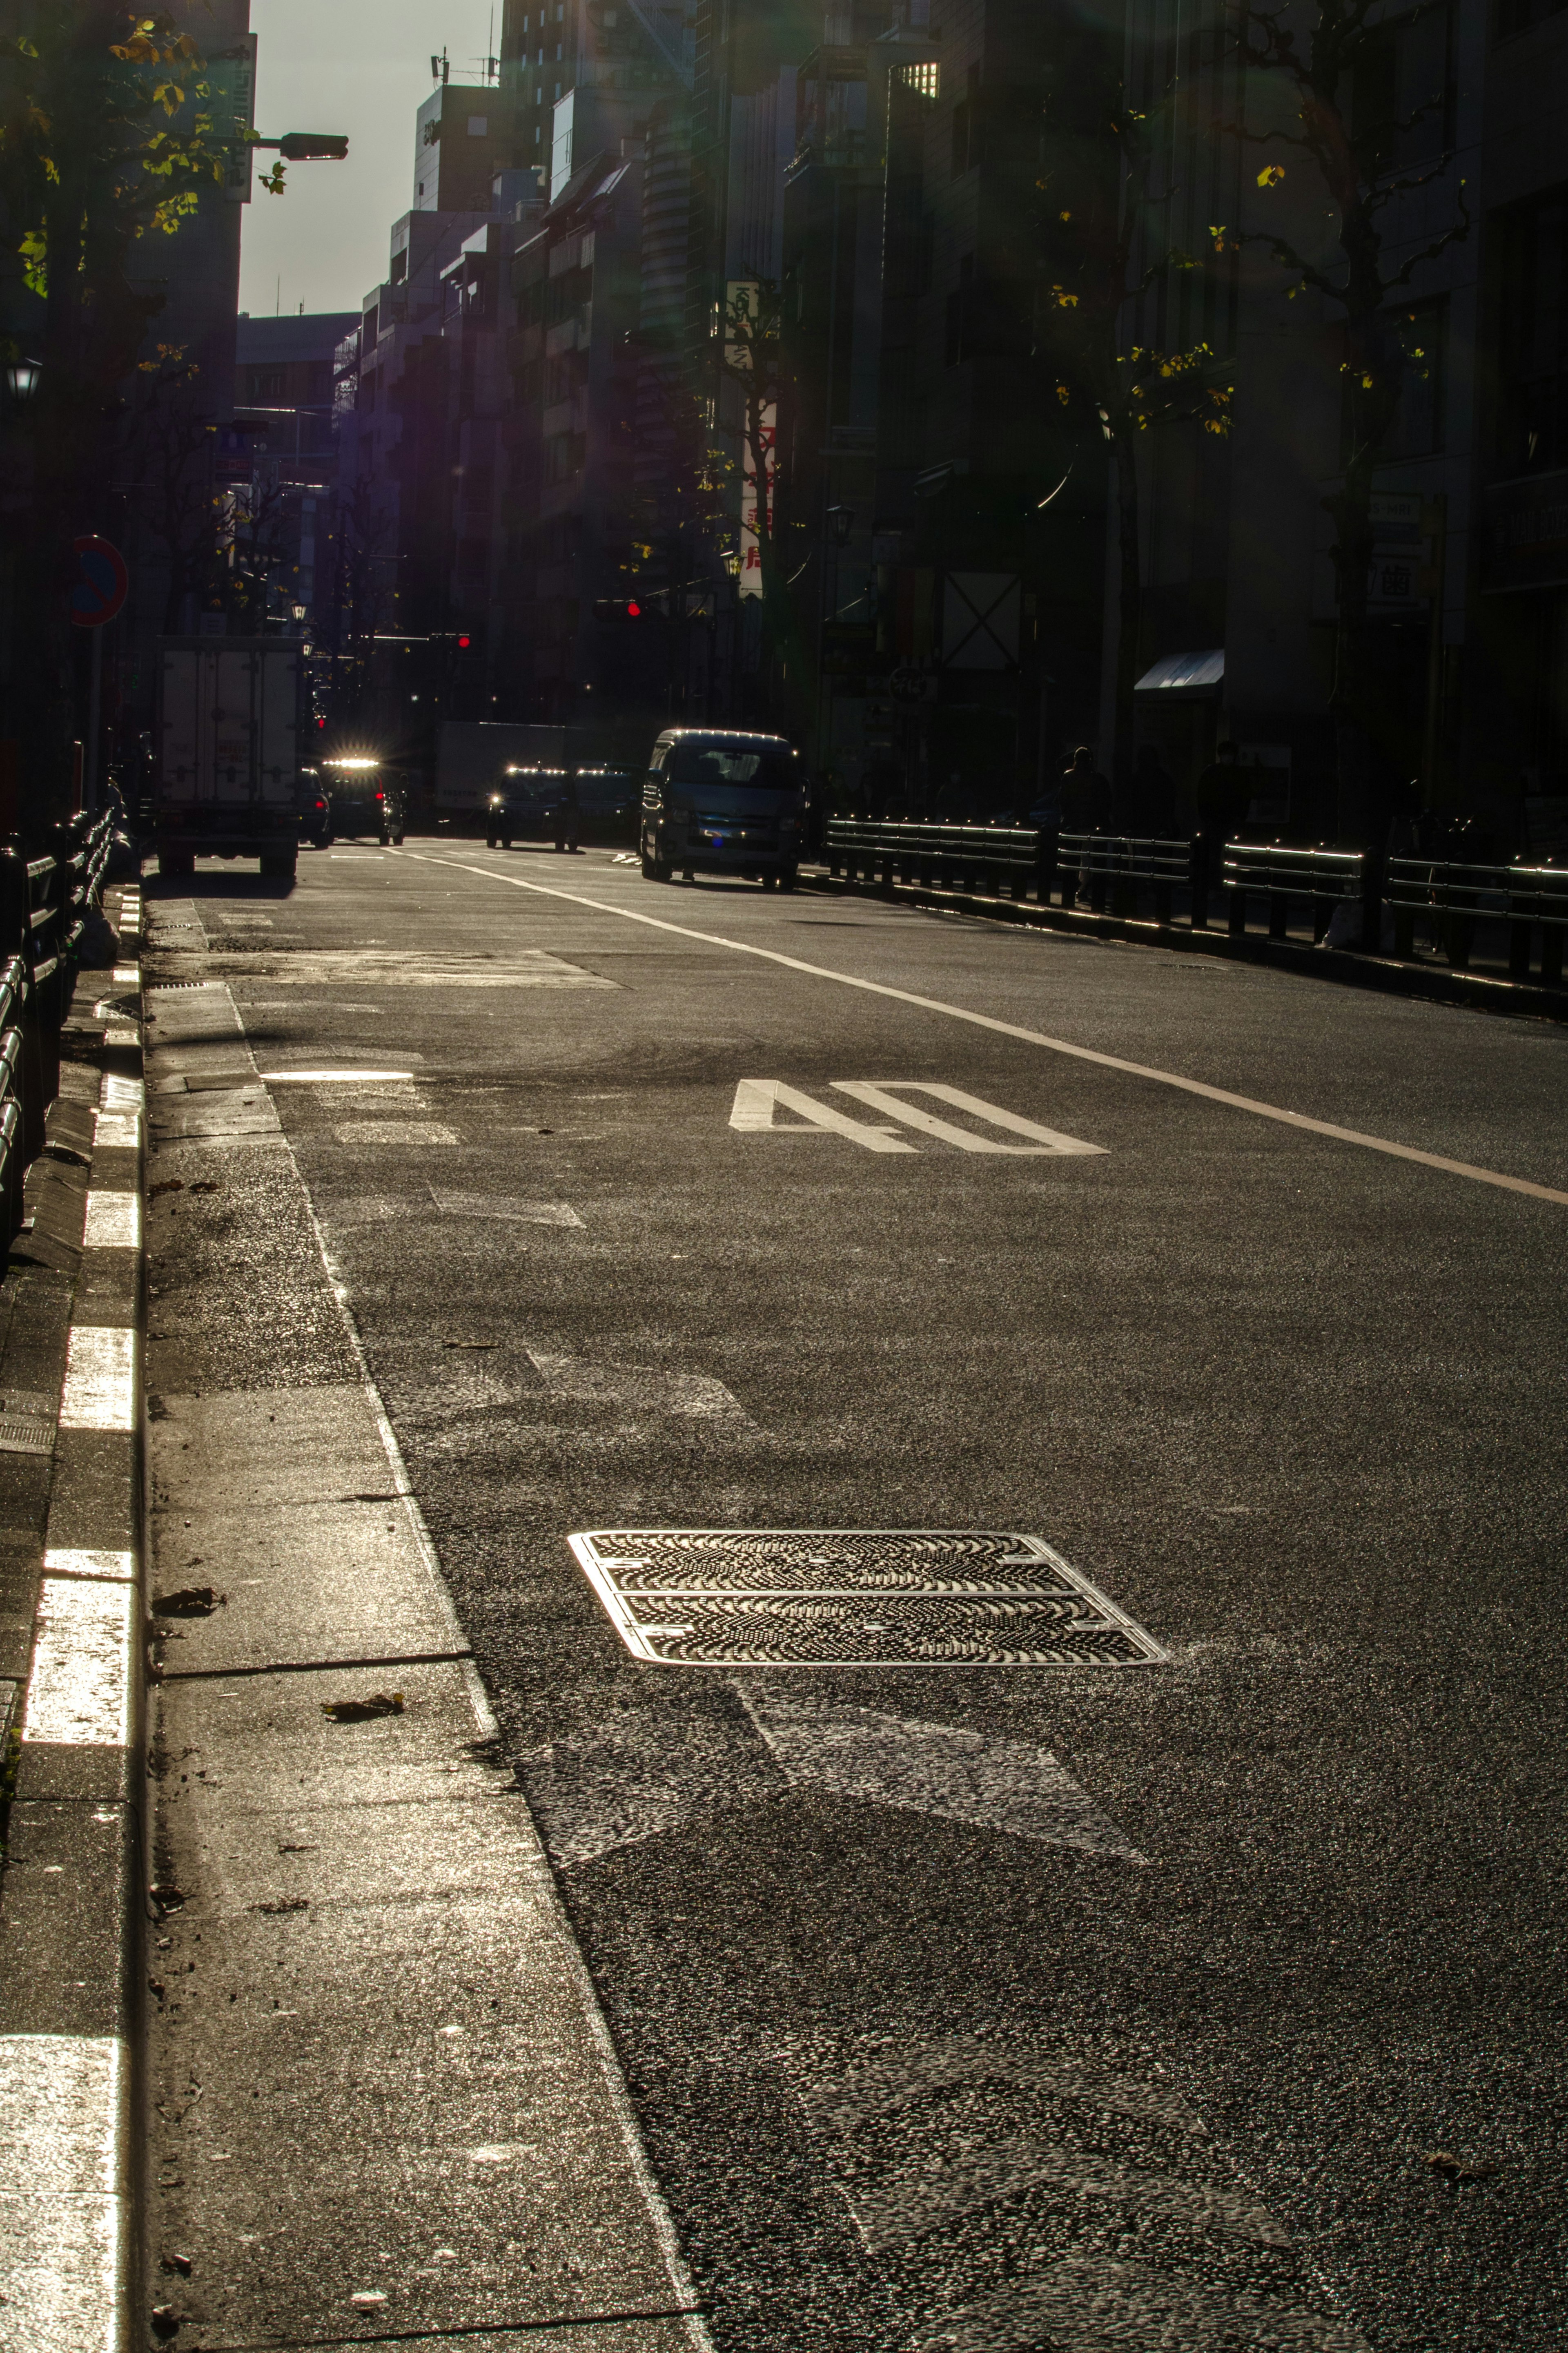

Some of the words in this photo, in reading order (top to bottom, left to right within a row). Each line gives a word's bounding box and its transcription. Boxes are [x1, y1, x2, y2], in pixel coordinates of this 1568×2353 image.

[1381, 565, 1411, 596] 歯
[891, 676, 925, 694] そば
[728, 1078, 1111, 1155] 40
